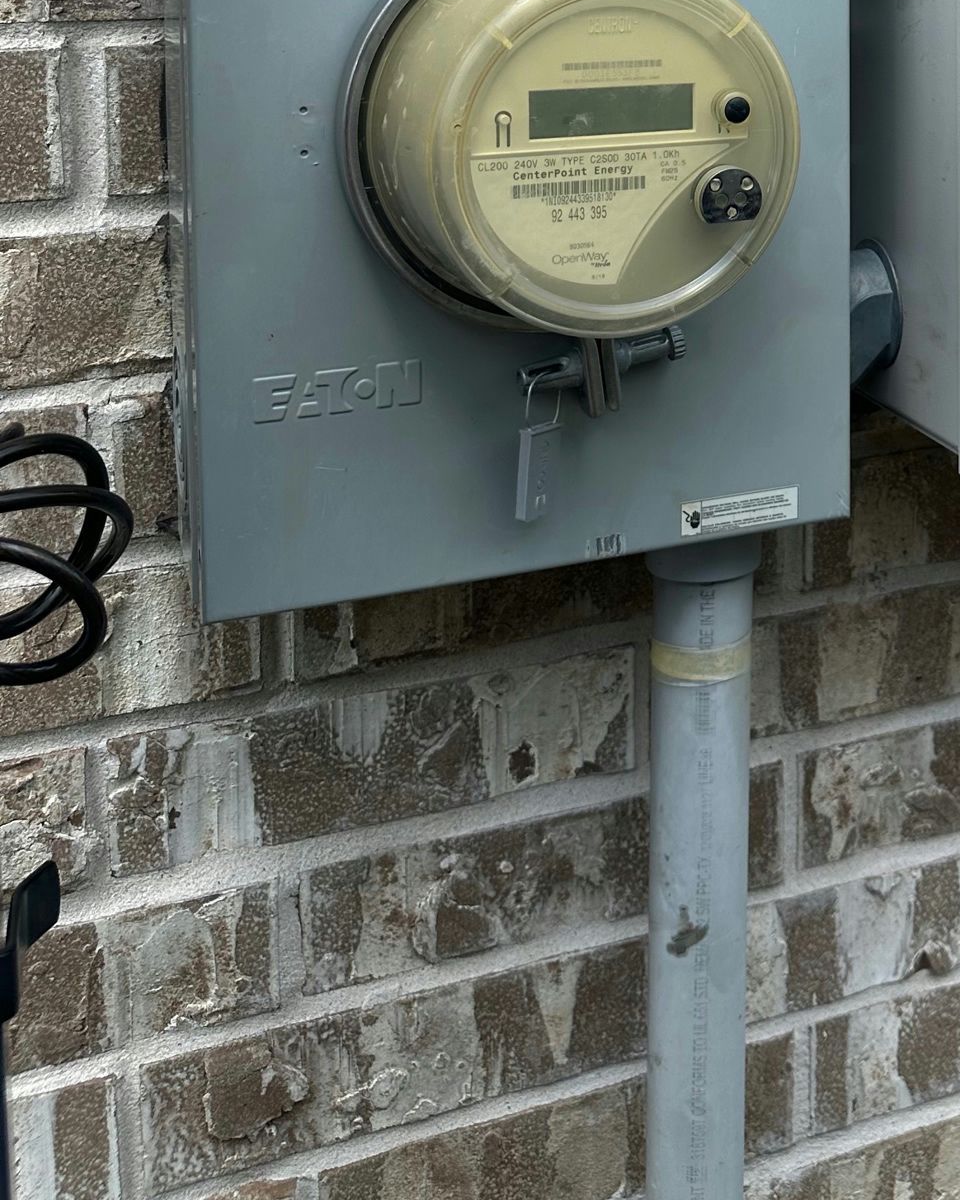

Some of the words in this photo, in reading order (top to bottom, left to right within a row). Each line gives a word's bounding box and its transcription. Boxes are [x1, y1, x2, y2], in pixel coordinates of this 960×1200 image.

[478, 161, 508, 172] CL200
[514, 159, 538, 170] 240V
[544, 158, 556, 167] 3W
[562, 156, 584, 166] TYPE
[624, 152, 648, 162] 30TA
[512, 167, 588, 182] CenterPoint
[594, 164, 633, 176] Energy
[551, 208, 563, 222] 92
[568, 207, 586, 221] 443
[590, 205, 608, 220] 395
[552, 252, 609, 266] OpenWay
[252, 358, 423, 425] EATON
[700, 615, 714, 626] IN
